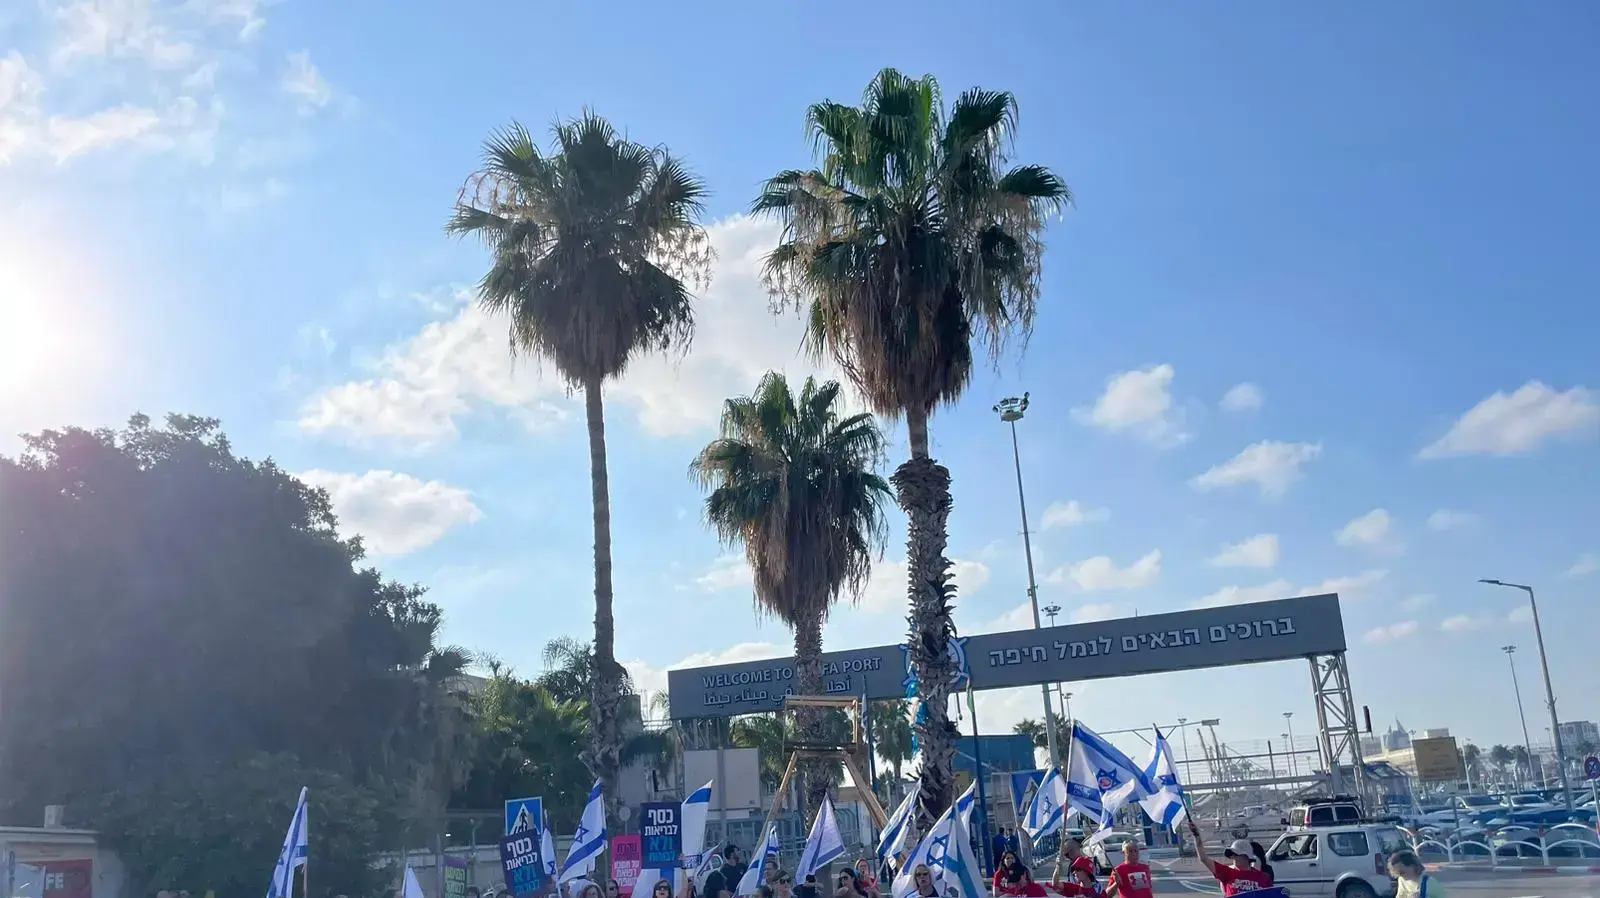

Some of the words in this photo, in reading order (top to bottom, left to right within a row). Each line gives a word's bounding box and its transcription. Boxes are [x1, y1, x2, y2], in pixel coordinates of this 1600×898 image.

[1209, 617, 1296, 642] ברוכים
[1054, 636, 1112, 659] לנמל
[1122, 628, 1200, 652] הבאים
[989, 645, 1047, 667] חיפה
[703, 669, 771, 689] WELCOME
[774, 667, 793, 681] TO
[843, 656, 882, 673] PORT
[703, 693, 731, 708] حيفا
[735, 689, 769, 704] ميناء
[648, 809, 674, 825] כסף
[644, 825, 678, 836] לבריאות
[506, 838, 532, 858] כסף
[649, 836, 672, 851] ולא
[505, 852, 538, 870] לבריאות
[513, 865, 537, 885] ולא
